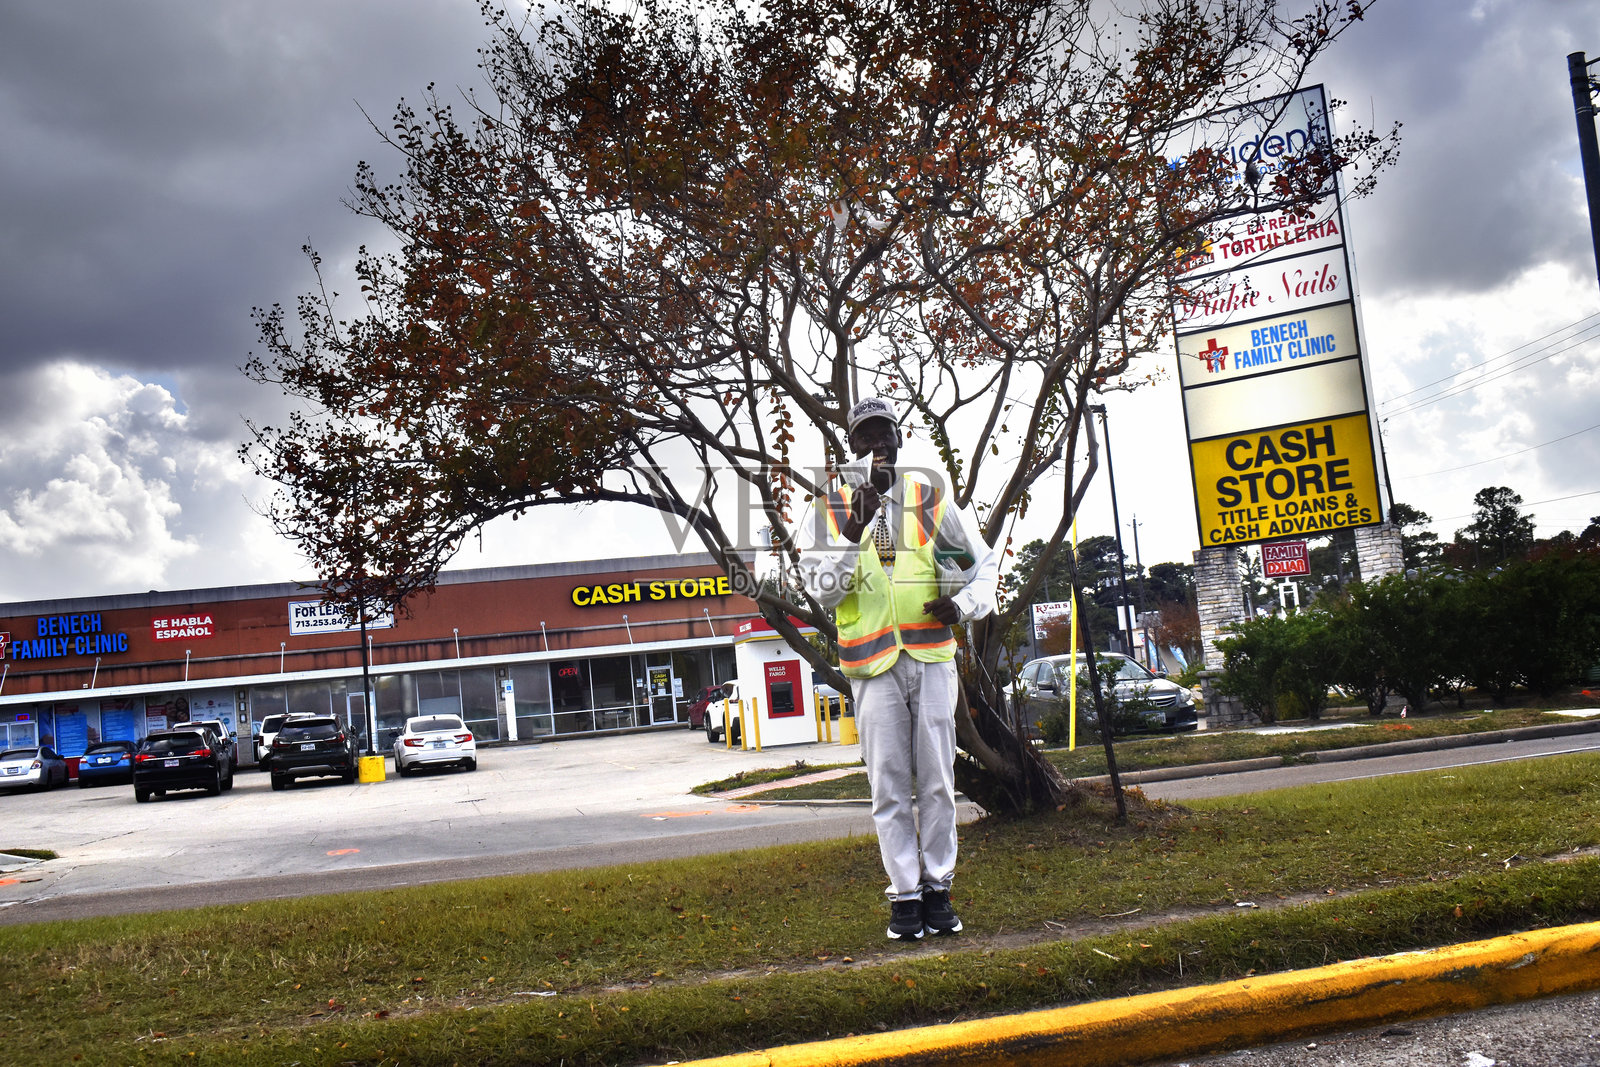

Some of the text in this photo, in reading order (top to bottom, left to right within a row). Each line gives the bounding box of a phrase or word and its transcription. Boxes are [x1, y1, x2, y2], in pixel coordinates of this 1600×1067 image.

[1193, 121, 1326, 170] rident
[1268, 214, 1306, 231] REAL
[1219, 220, 1339, 260] TORTILLERIA
[1268, 263, 1339, 303] Nails
[1251, 320, 1309, 348] BENECH
[1234, 334, 1336, 370] FAMILY CLINIC
[1225, 425, 1336, 471] CASH
[1216, 458, 1353, 508] STORE
[1218, 493, 1358, 526] TITLE LOANS &
[1209, 507, 1372, 543] CASH ADVANCES
[1264, 544, 1304, 560] FAMILY
[1266, 559, 1306, 575] DOLLAR
[571, 577, 732, 607] CASH STORE
[37, 613, 102, 637] BENECH
[153, 615, 213, 629] SE HABLA
[295, 604, 352, 618] FOR LEAS
[12, 633, 128, 660] FAMILY CLINIC
[156, 625, 212, 640] ESPAÑOL
[558, 667, 578, 677] OPEN
